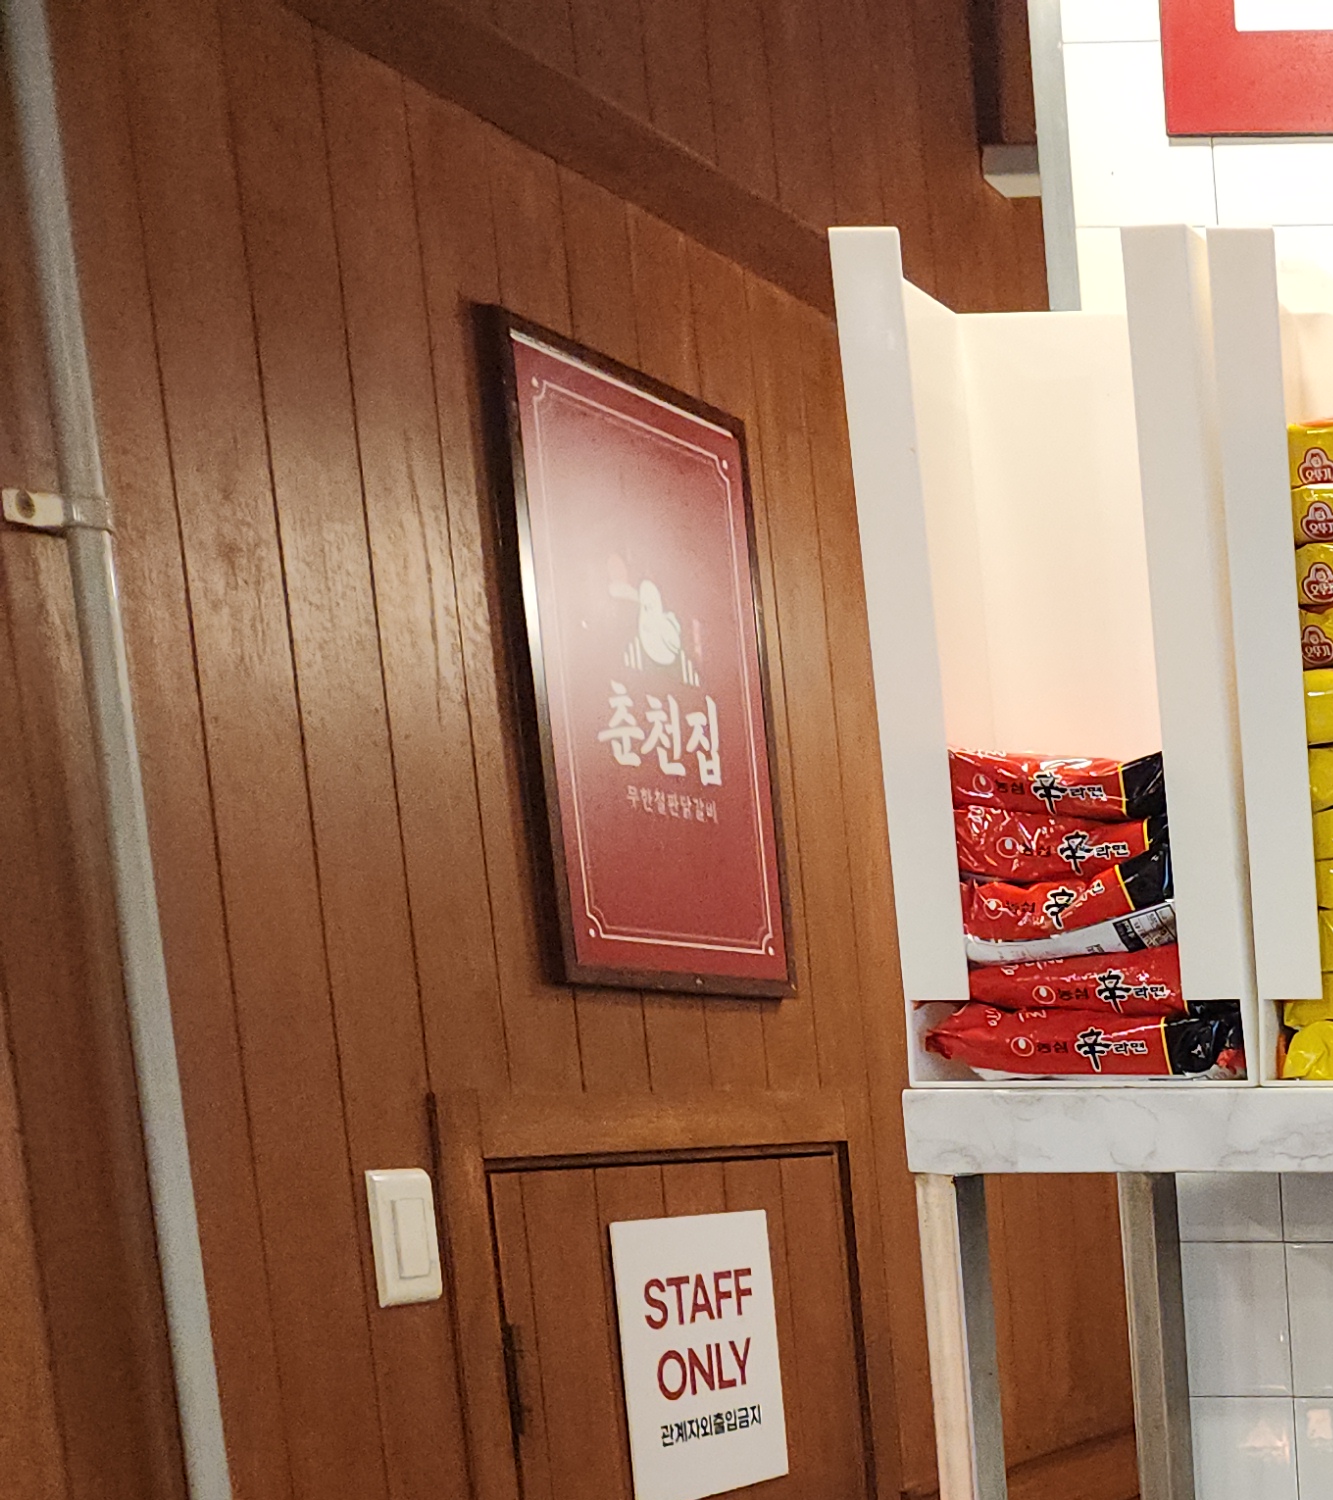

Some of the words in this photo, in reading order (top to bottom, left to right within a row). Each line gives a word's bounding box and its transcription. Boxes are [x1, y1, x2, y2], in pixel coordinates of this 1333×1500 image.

[598, 679, 722, 786] 춘천집
[644, 1267, 753, 1330] STAFF
[657, 1337, 752, 1401] ONLY
[661, 1404, 762, 1447] 관계자외출입금지
